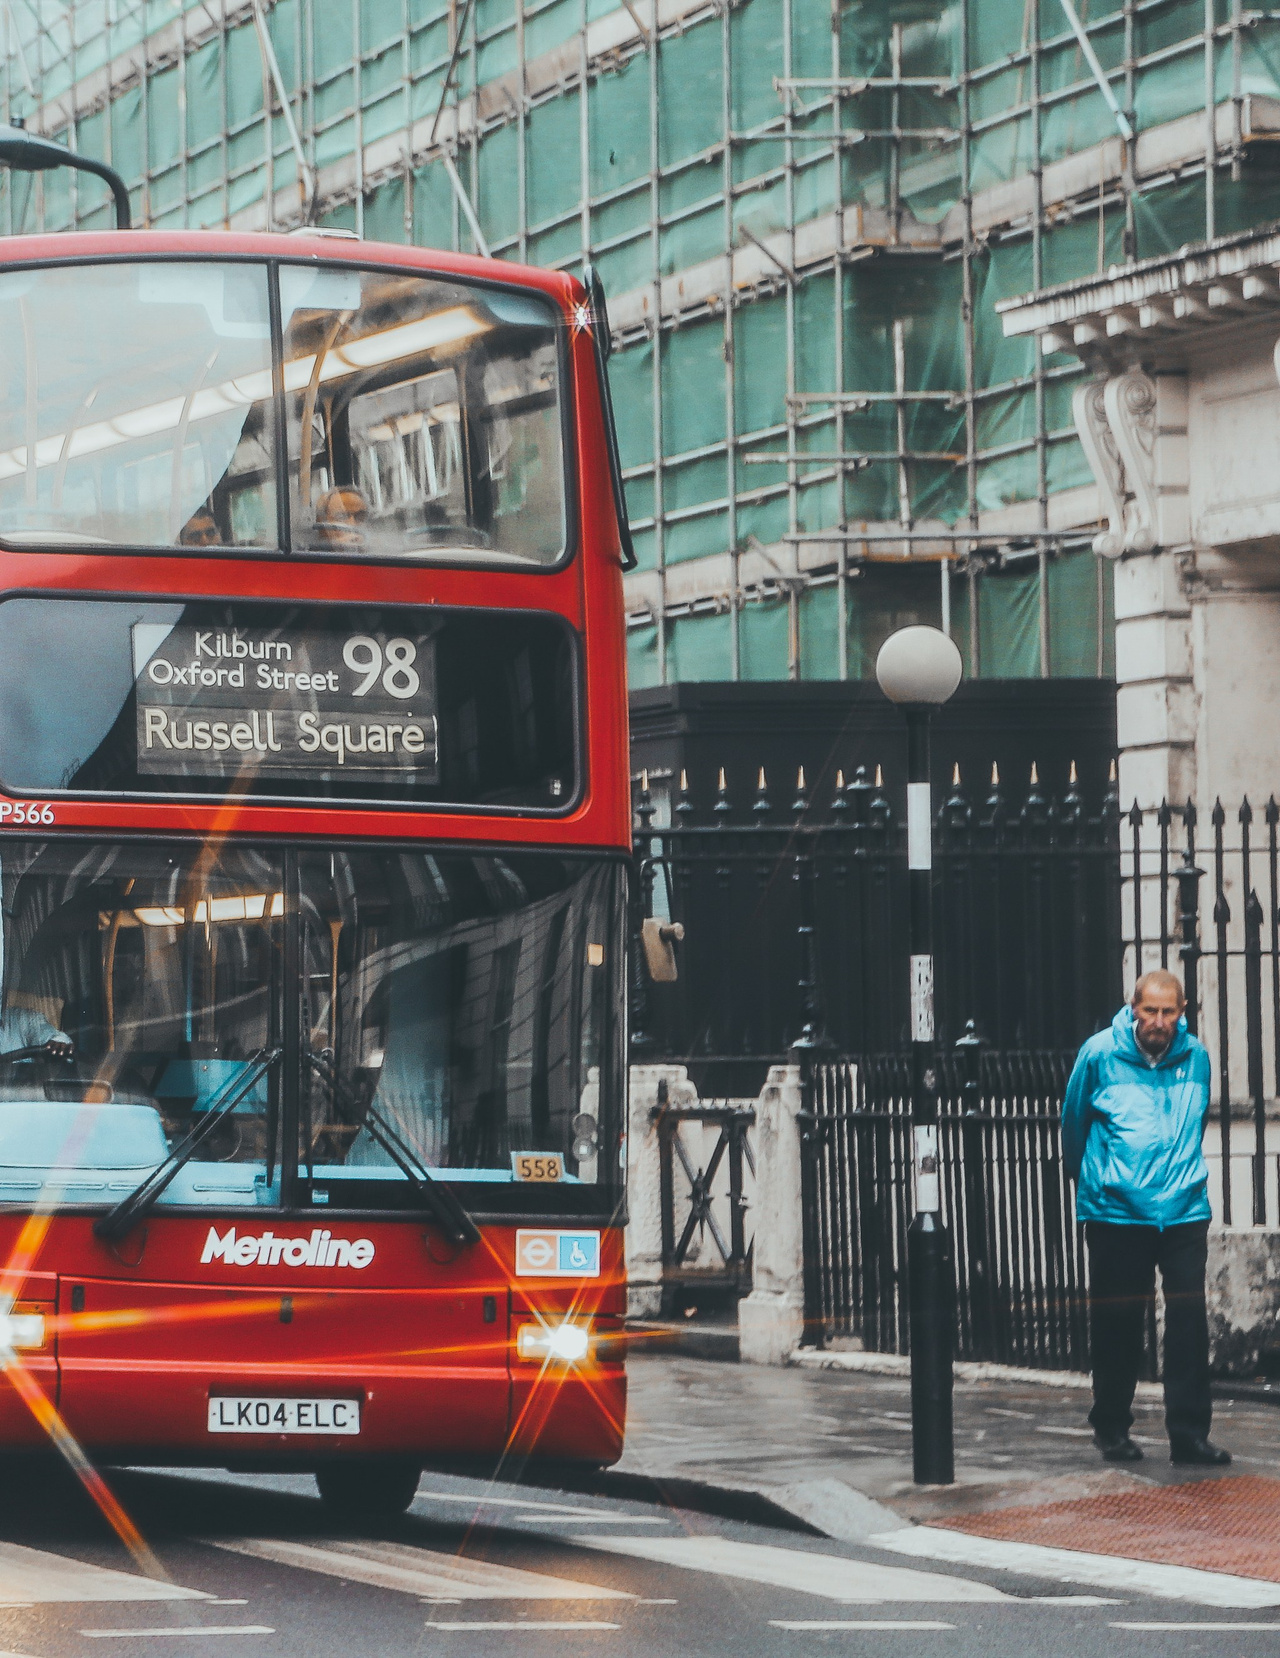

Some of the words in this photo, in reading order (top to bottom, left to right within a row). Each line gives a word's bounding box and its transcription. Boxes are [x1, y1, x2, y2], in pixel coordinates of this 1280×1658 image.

[194, 631, 292, 661] Kilburn
[148, 658, 245, 688] Oxford
[256, 663, 339, 692] Street
[342, 635, 420, 699] 98
[145, 707, 281, 752] Russell
[298, 711, 425, 765] Square
[520, 1159, 559, 1179] 558
[200, 1226, 376, 1269] Metroline
[220, 1403, 286, 1426] LK04
[297, 1404, 347, 1427] ELC
